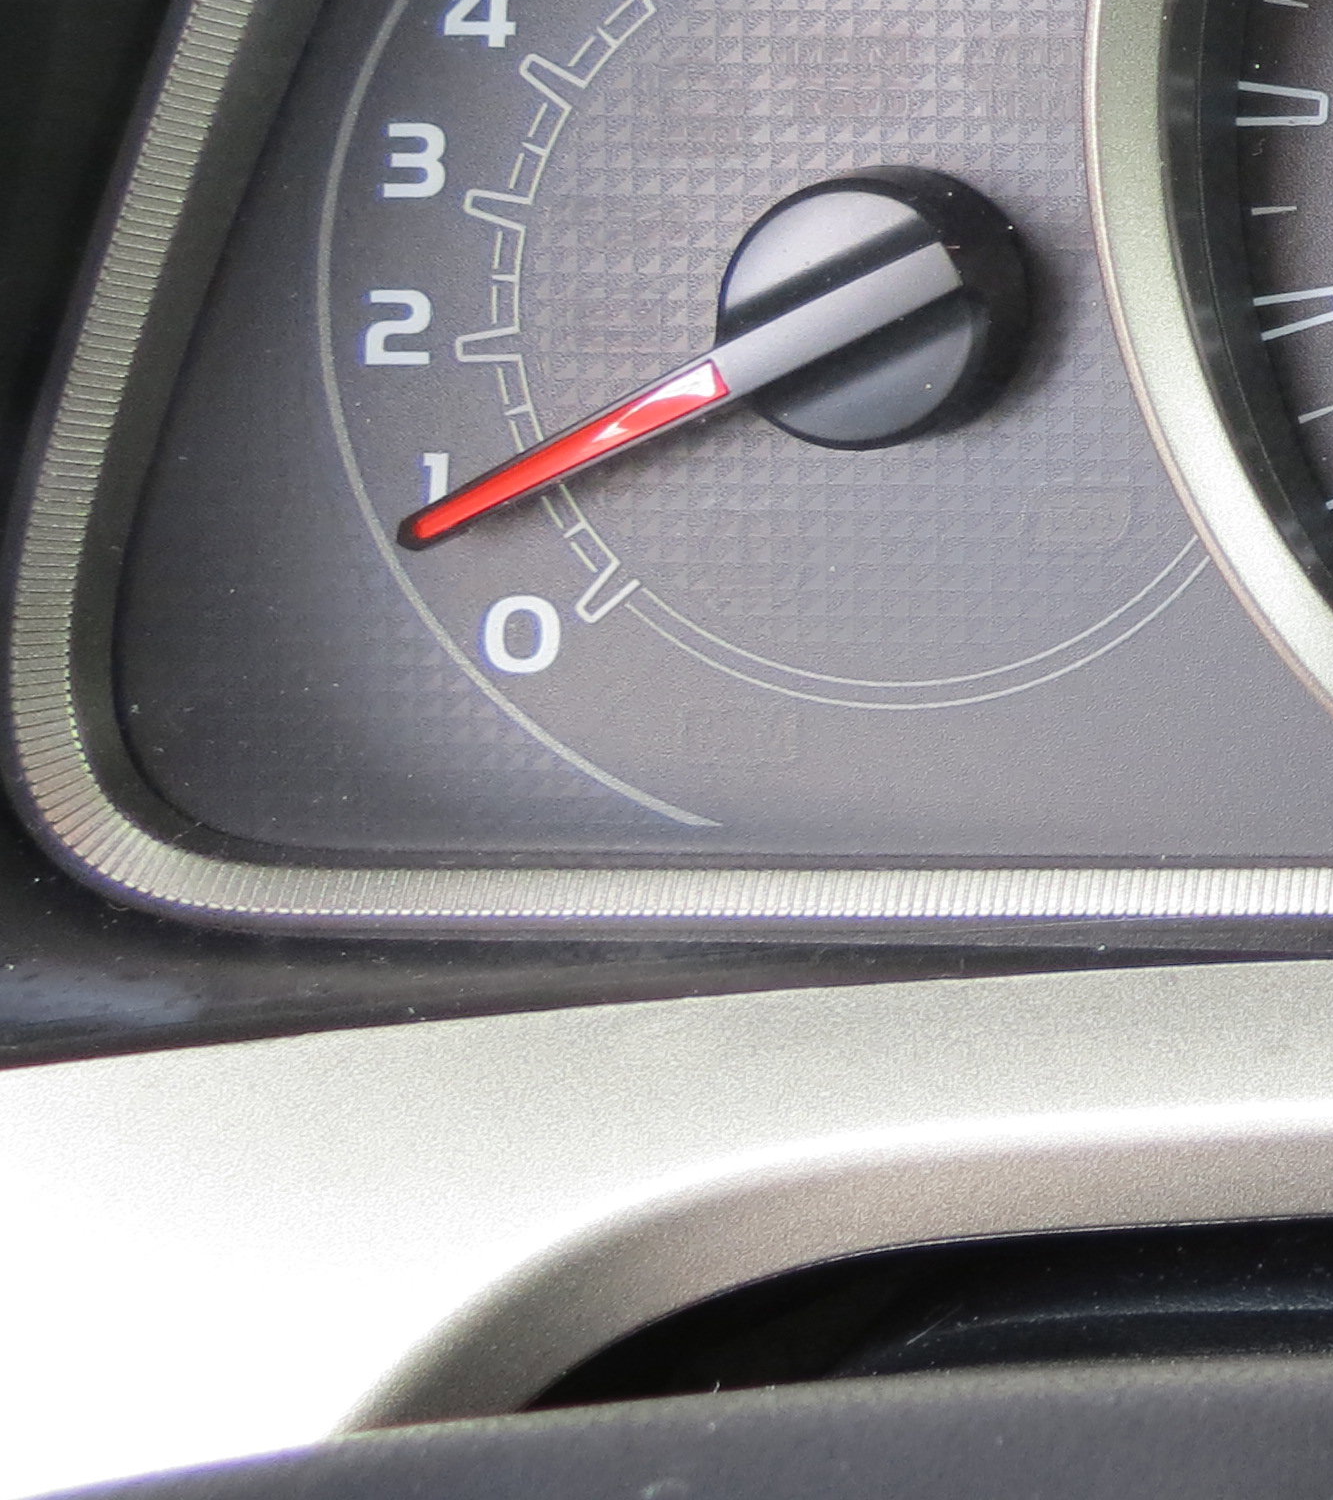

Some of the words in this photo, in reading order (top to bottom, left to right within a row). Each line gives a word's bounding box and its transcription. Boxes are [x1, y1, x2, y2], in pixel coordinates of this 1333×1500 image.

[382, 121, 447, 199] 3
[364, 288, 433, 366] 2
[421, 450, 451, 506] 1
[483, 594, 562, 675] 0
